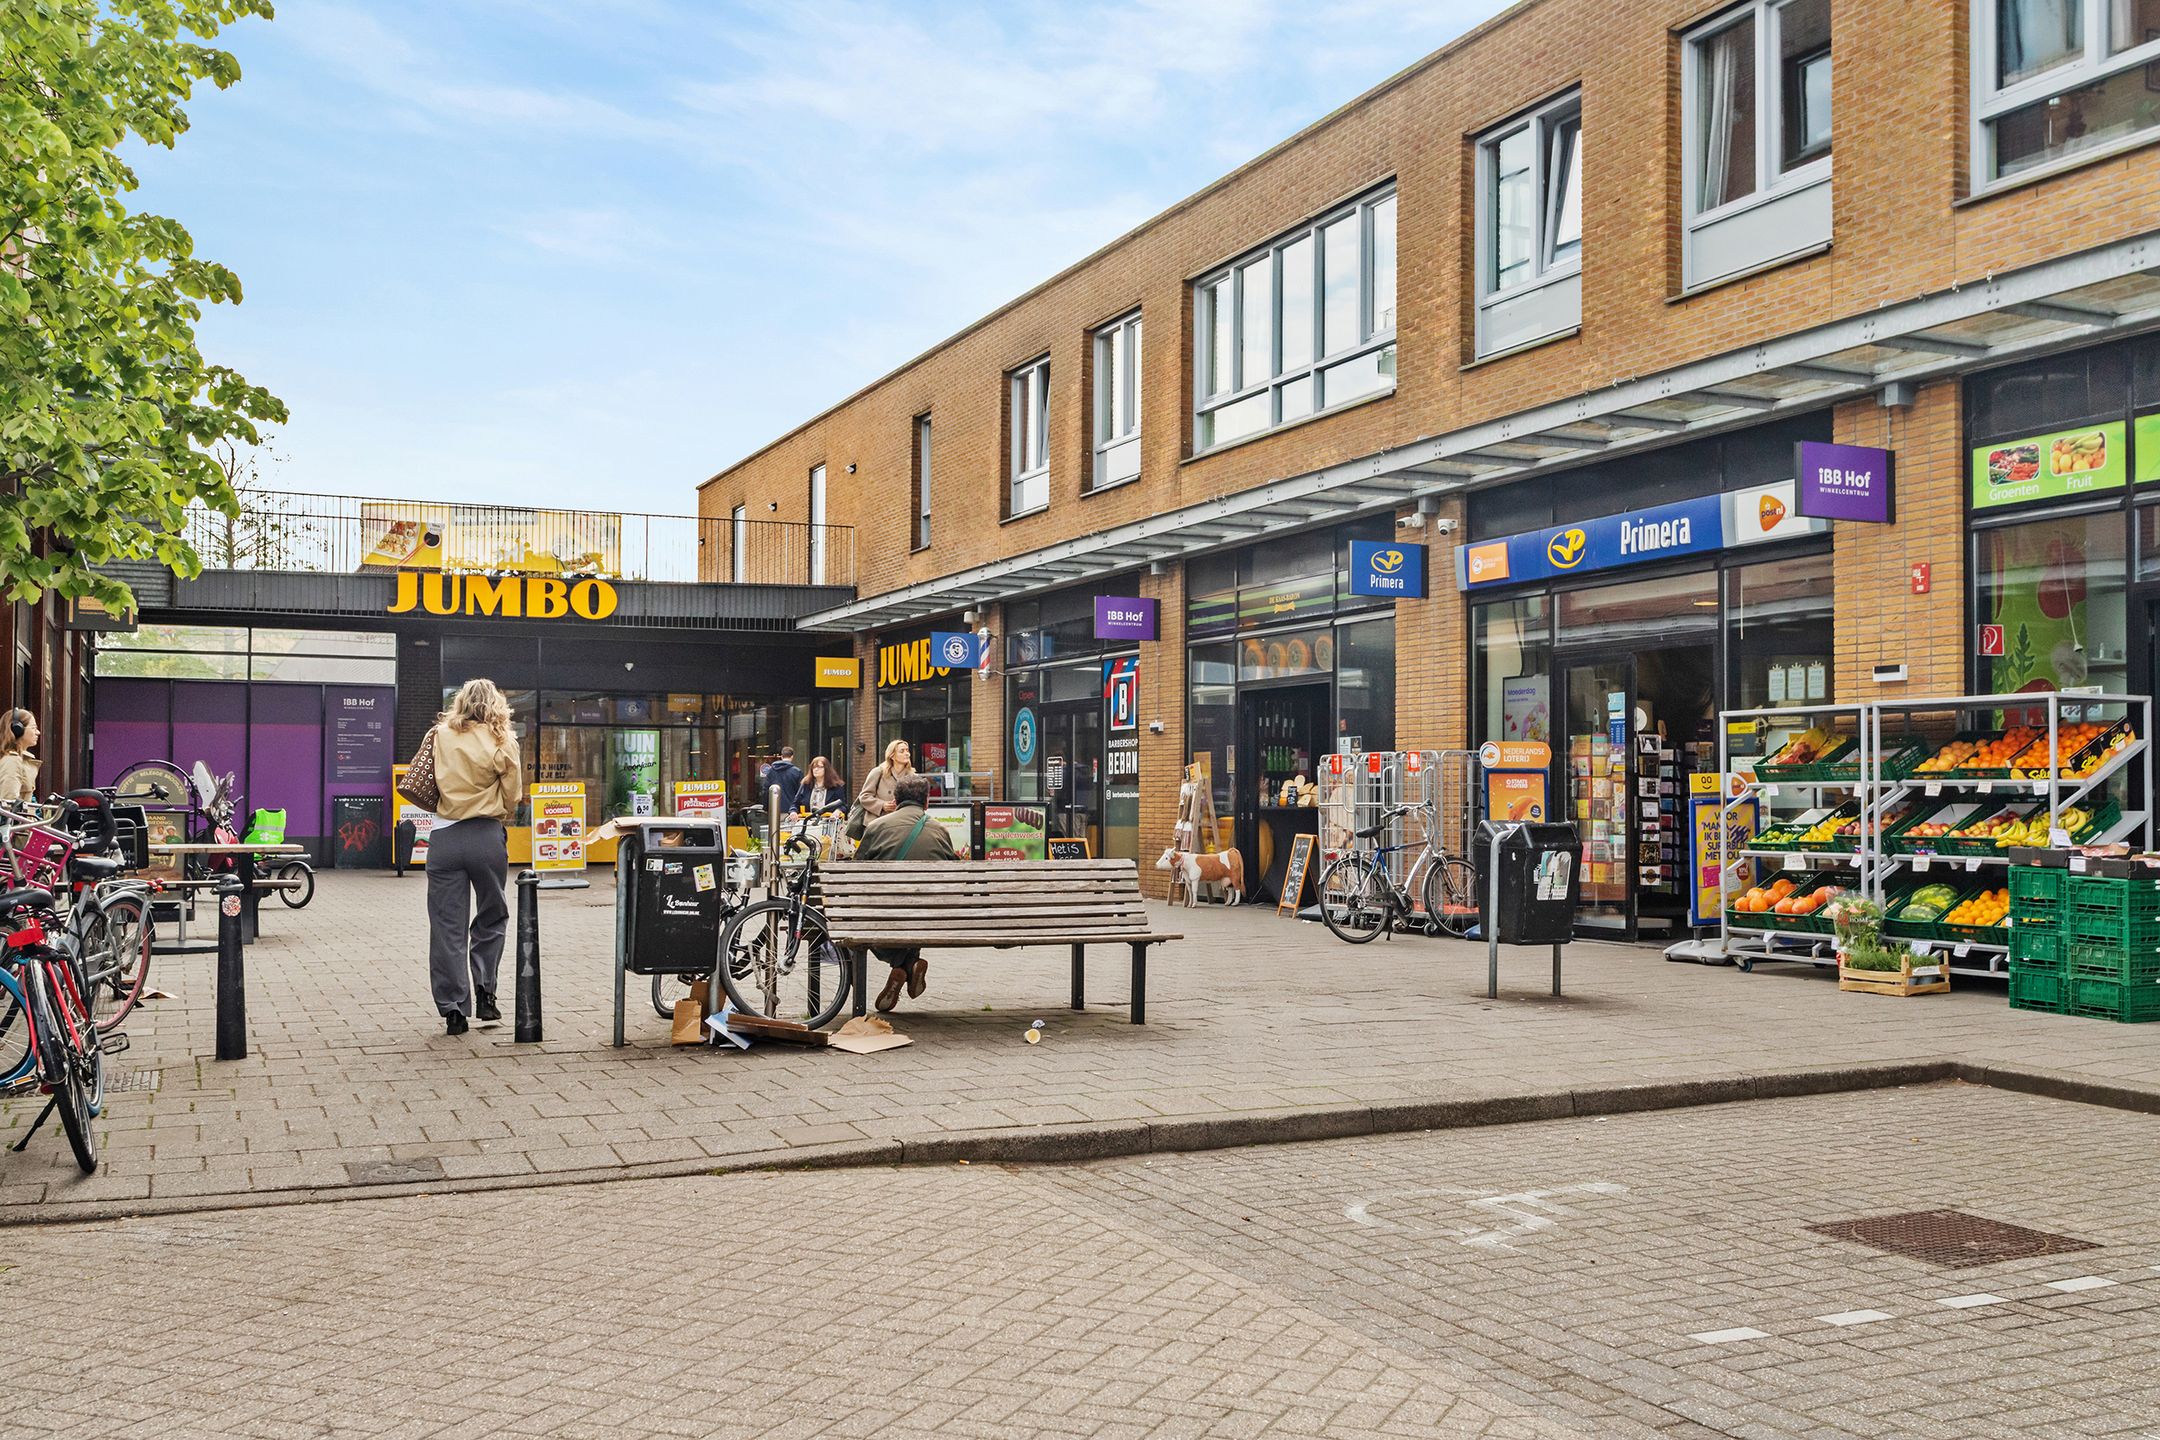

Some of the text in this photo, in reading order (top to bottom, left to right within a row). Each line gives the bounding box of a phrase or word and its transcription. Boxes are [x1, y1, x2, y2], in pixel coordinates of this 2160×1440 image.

[1845, 470, 1871, 489] Hof
[2066, 475, 2093, 490] Fruit
[1819, 487, 1869, 497] WINKELCENTRUM
[1989, 484, 2039, 501] Groenten
[1620, 517, 1691, 555] Primera
[1370, 574, 1404, 589] Primera
[387, 572, 618, 620] JUMBO
[1125, 611, 1143, 622] Hof
[877, 638, 950, 688] JUMB
[823, 668, 852, 677] JUMBO
[359, 698, 375, 706] Hof
[1119, 682, 1128, 721] B
[613, 733, 655, 753] TUIN
[1108, 738, 1138, 749] BARBERSHOP
[1503, 747, 1545, 756] NEDERLANDSE
[613, 753, 655, 766] MARKT
[1108, 751, 1138, 775] BEBAN
[1503, 755, 1530, 763] LOTERIJ
[538, 784, 579, 793] JUMBO
[683, 783, 719, 792] JUMBO
[1714, 812, 1738, 821] VOR
[985, 831, 1042, 839] Paardenworst
[1704, 832, 1713, 840] IK
